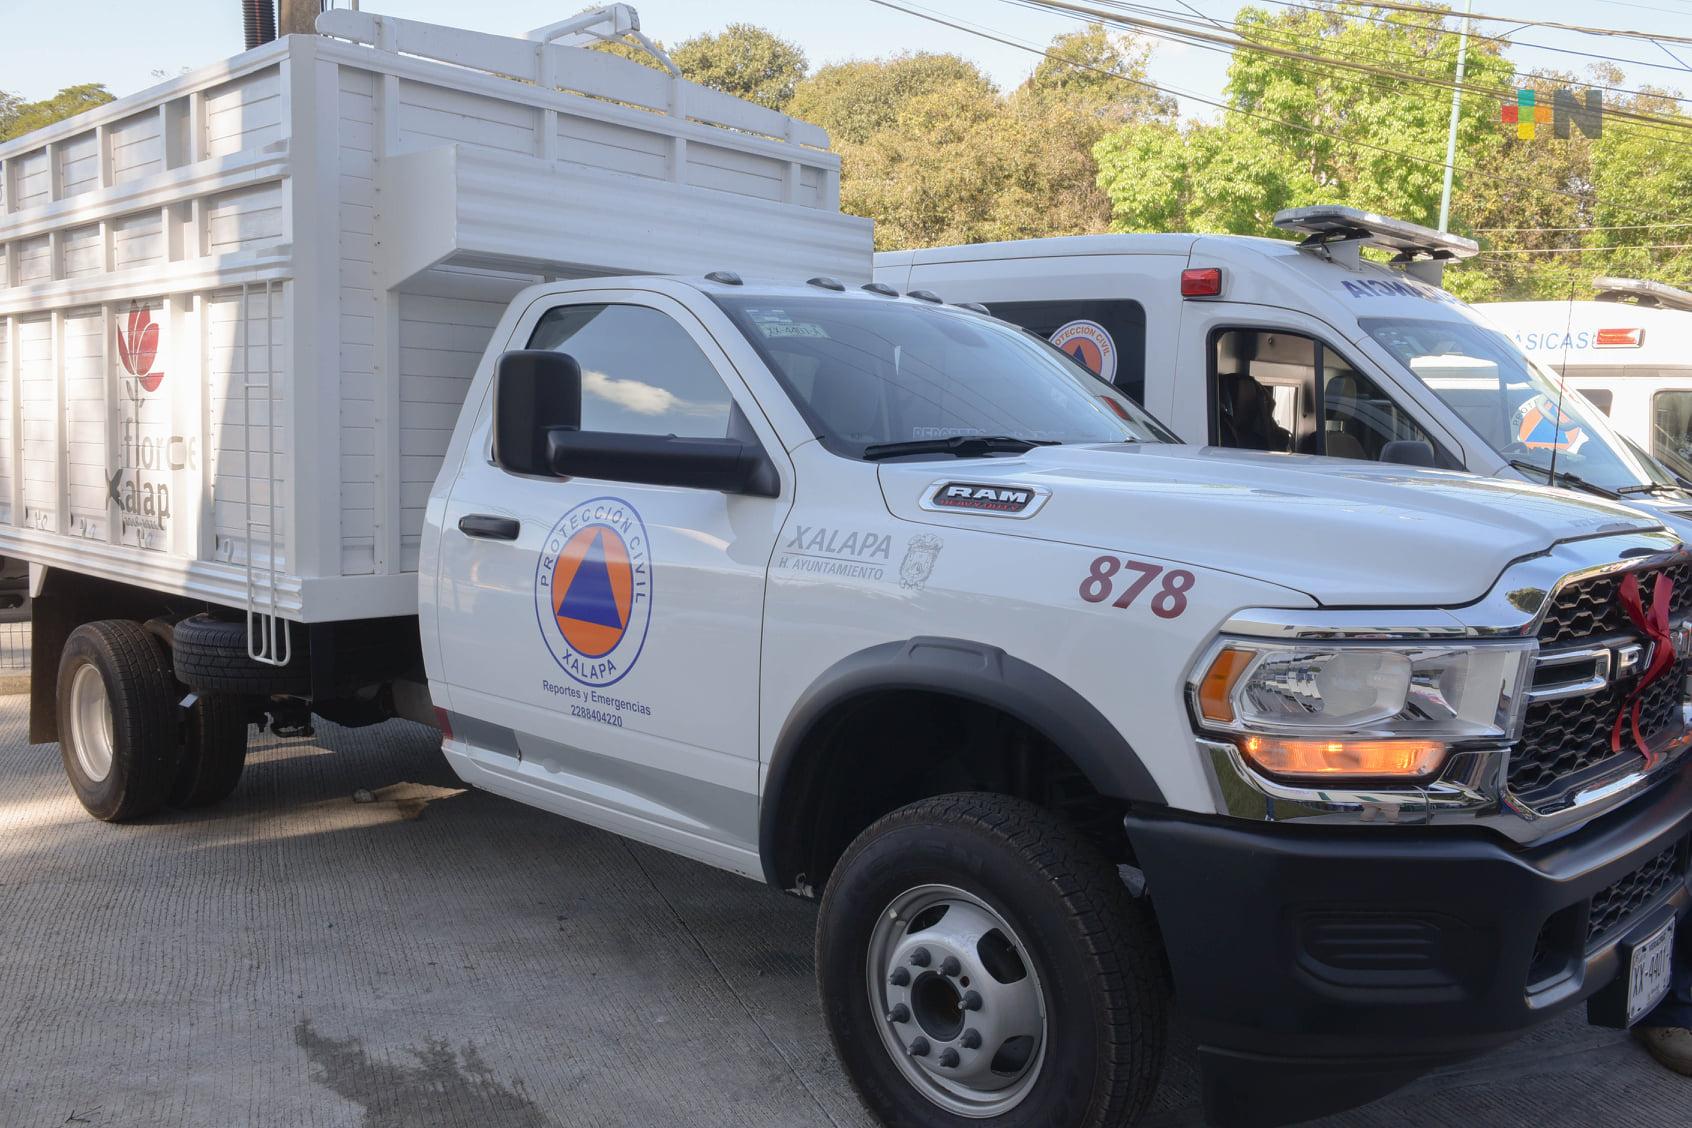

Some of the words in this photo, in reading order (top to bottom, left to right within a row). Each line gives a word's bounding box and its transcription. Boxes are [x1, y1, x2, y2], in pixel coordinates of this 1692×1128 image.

[947, 487, 1028, 503] RAM
[540, 506, 633, 587] PROTECCIÓN
[629, 535, 647, 604] CIVIL
[787, 525, 893, 560] XALAPA
[778, 557, 790, 570] H.
[792, 559, 884, 581] AYUNTAMIENTO
[1079, 555, 1195, 619] 878
[562, 648, 617, 680] XALAPA
[542, 679, 581, 699] Reportes
[582, 691, 589, 703] y
[591, 690, 652, 716] Emergencias
[570, 704, 623, 728] 2288404220
